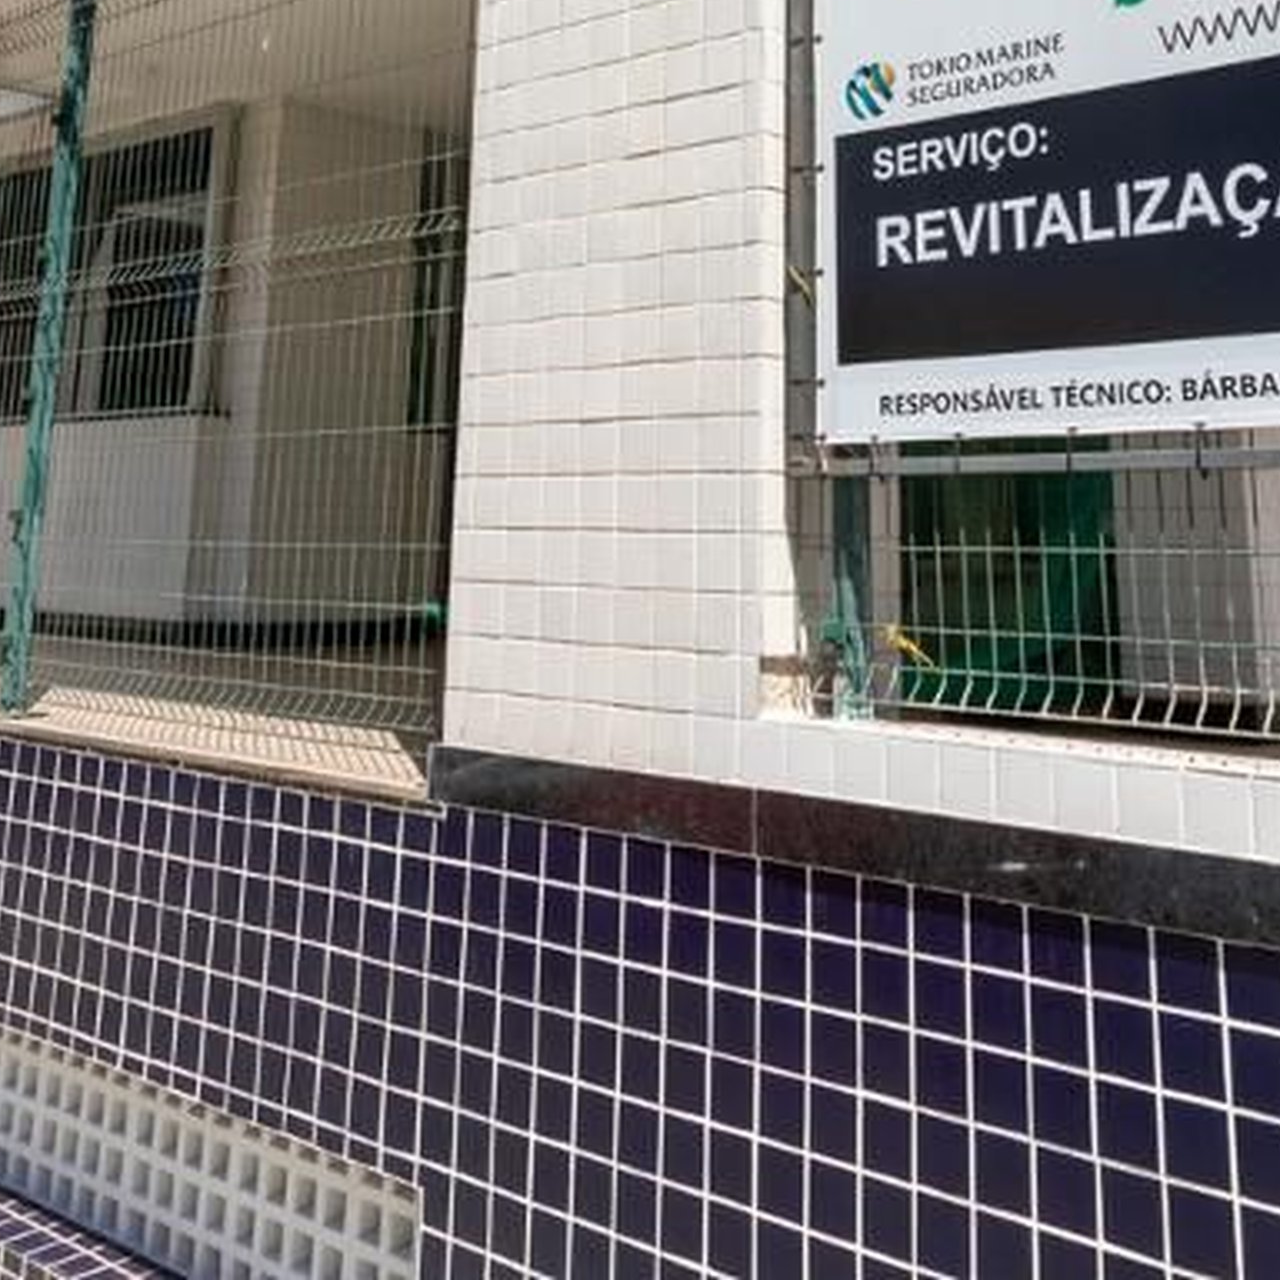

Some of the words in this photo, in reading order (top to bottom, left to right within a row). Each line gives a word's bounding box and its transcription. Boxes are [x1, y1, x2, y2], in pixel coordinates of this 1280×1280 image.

[907, 52, 971, 81] TOKIO
[973, 32, 1066, 69] MARINE
[906, 62, 1056, 106] SEGURADORA
[872, 122, 1050, 181] SERVIÇO:
[879, 384, 1043, 416] RESPONSÁVEL
[1050, 377, 1173, 408] TÉCNICO:
